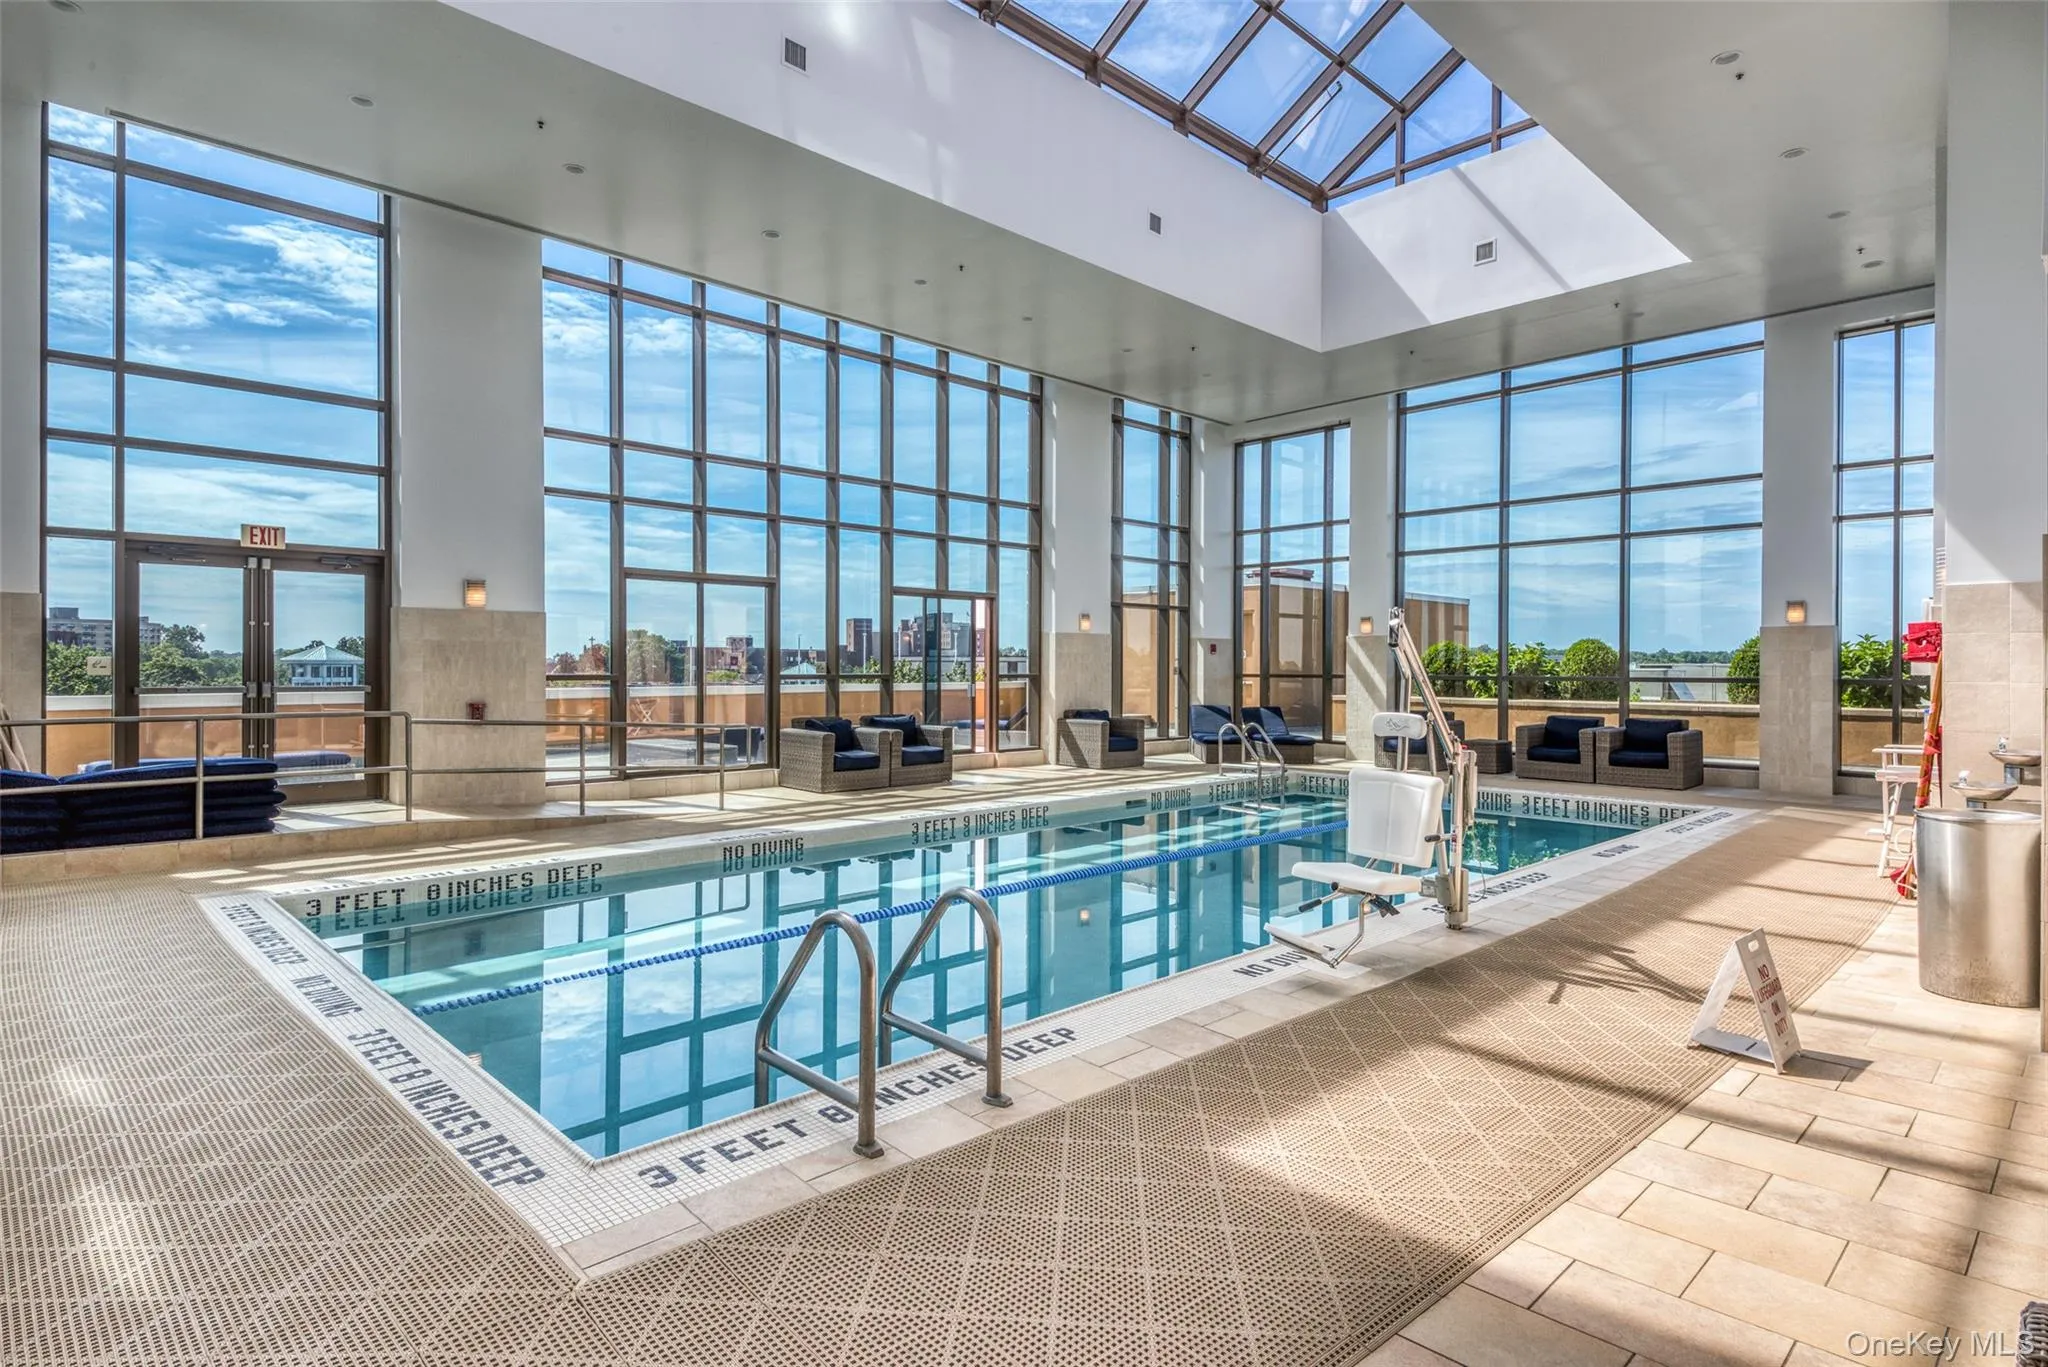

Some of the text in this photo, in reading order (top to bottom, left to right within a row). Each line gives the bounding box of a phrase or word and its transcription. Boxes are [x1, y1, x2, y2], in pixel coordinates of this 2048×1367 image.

[249, 526, 280, 547] EXIT
[1309, 776, 1336, 788] FEET
[1150, 787, 1192, 802] NO DIVING
[1477, 791, 1512, 804] IVING
[1521, 795, 1530, 806] 3
[1533, 796, 1570, 810] FEET
[1594, 801, 1650, 817] INCHES
[911, 822, 919, 834] 3
[924, 817, 956, 834] FEET
[963, 815, 970, 827] 9
[975, 809, 1016, 827] INCHES
[1021, 805, 1049, 820] DEEP
[722, 837, 804, 861] NO DIVING
[306, 899, 321, 917] 3
[335, 888, 405, 914] FEET
[427, 883, 440, 901] 8
[448, 872, 533, 898] INCHES
[547, 863, 603, 885] DEEP
[1233, 964, 1274, 977] NO
[1757, 964, 1770, 981] NO
[289, 973, 363, 1018] NO DIVING
[1756, 977, 1782, 1003] LIFEGUARD
[1774, 1017, 1789, 1037] DUTY
[347, 1028, 546, 1187] 3 FEET 8 INCHES DEEP
[637, 1027, 1077, 1188] 3 FEET 8 NCHE DEEP
